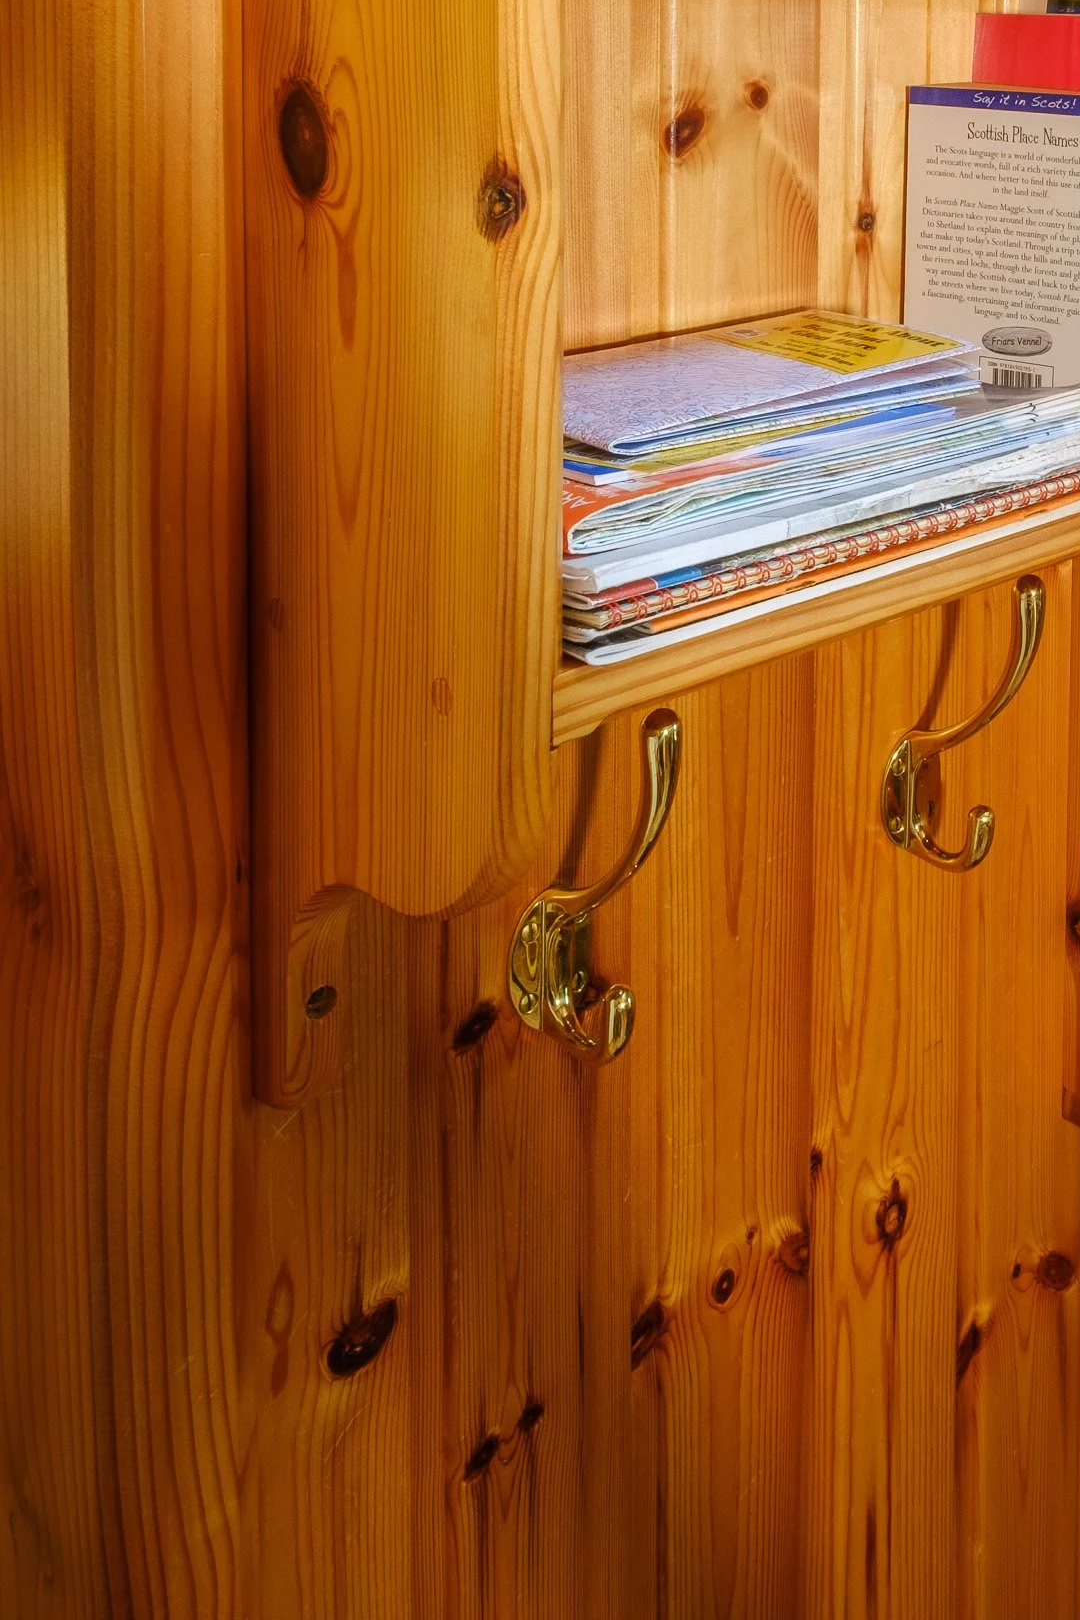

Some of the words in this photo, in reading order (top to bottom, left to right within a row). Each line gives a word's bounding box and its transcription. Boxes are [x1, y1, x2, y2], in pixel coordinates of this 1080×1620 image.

[972, 92, 995, 106] Say
[999, 94, 1012, 105] it
[1014, 96, 1026, 106] in
[1032, 97, 1077, 110] Scots!
[967, 121, 1010, 143] Scottish
[1011, 126, 1040, 145] Place
[1043, 127, 1080, 148] Names
[935, 145, 948, 154] The
[949, 146, 968, 155] Scots
[969, 148, 999, 159] language
[1013, 152, 1035, 161] world
[926, 156, 939, 164] and
[940, 159, 973, 167] evocative
[974, 161, 998, 171] words,
[998, 162, 1011, 171] full
[1041, 168, 1068, 178] variety
[926, 170, 958, 178] occasion.
[958, 170, 974, 179] And
[975, 172, 997, 181] where
[998, 174, 1021, 183] better
[1030, 177, 1044, 186] find
[1045, 178, 1059, 187] this
[1001, 186, 1013, 194] the
[1014, 187, 1029, 196] land
[1030, 189, 1050, 198] itself.
[933, 197, 959, 206] Scottish
[959, 199, 976, 208] Place
[977, 200, 999, 210] Names
[1000, 203, 1026, 214] Maggie
[1026, 205, 1045, 215] Scott
[884, 330, 945, 348] About
[991, 336, 1015, 346] Friars
[1017, 336, 1042, 346] Vennel
